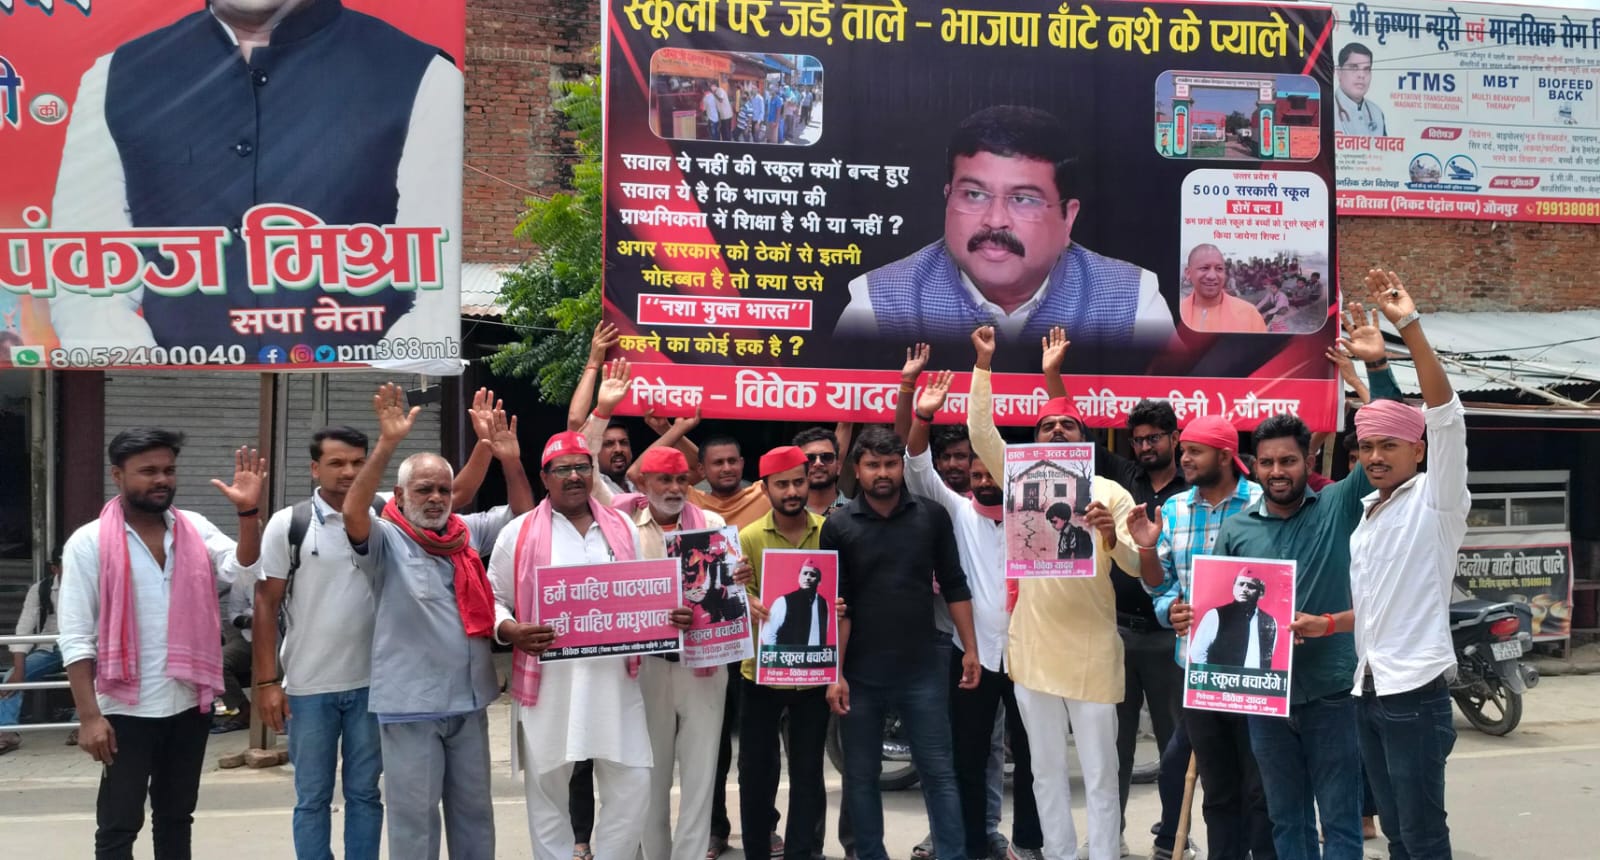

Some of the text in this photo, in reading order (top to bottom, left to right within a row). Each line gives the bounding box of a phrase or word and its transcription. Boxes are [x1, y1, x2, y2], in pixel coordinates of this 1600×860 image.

[727, 0, 772, 37] पर
[842, 0, 907, 43] ताले
[940, 8, 1040, 47] भाजपा
[1048, 2, 1099, 50] बाँटे
[1108, 8, 1161, 55] नशे
[1168, 10, 1201, 53] के
[1210, 12, 1288, 58] प्याले
[1297, 25, 1305, 57] !
[1350, 2, 1369, 37] श्री
[1374, 10, 1420, 45] कृष्णा
[1425, 8, 1461, 50] न्यूरो
[1466, 18, 1485, 43] एवं
[1489, 14, 1556, 47] मानसिक
[1560, 16, 1588, 49] रोग
[1398, 72, 1456, 93] rTMS
[1483, 75, 1519, 89] MBT
[1539, 78, 1593, 90] BIOFEED
[1472, 93, 1491, 101] MULTI
[1548, 90, 1583, 101] BACK
[38, 101, 59, 118] की
[1335, 131, 1405, 152] रिनाथ यादव
[620, 152, 910, 188] सवाल ये नहीं की स्कूल क्यों बन्द हुए
[620, 180, 827, 207] सवाल ये है कि भाजपा की
[1193, 182, 1310, 201] 5000 सरकारी स्कूल
[1253, 205, 1271, 214] बन्द
[1336, 194, 1355, 209] गंज
[1356, 195, 1389, 209] तिराहा
[1391, 195, 1424, 212] (निकट
[1427, 197, 1454, 214] पेट्रोल
[1456, 199, 1481, 216] पम्प)
[1483, 200, 1519, 217] जौनपुर
[620, 207, 903, 235] प्राथमिकता में शिक्षा है भी या नहीं ?
[0, 203, 447, 296] पंकज मिश्रा
[616, 239, 862, 266] अगर सरकार को ठेकों से इतनी
[641, 265, 824, 293] मोहब्बत है तो क्या उसे
[229, 297, 386, 334] सपा नेता
[702, 300, 740, 324] मुक्त
[50, 344, 246, 368] 8052400040
[337, 338, 460, 362] pm368mb
[619, 331, 805, 358] कहने का कोई हक है ?
[631, 376, 704, 406] निवेदक
[735, 370, 819, 409] विवेक
[1457, 552, 1491, 577] दिलीप
[1491, 552, 1514, 576] बाटी
[1543, 551, 1564, 575] वाले
[544, 577, 671, 604] हमें चाहिए पाठशाला
[574, 609, 612, 633] चाहिए
[761, 651, 778, 664] हम
[779, 651, 805, 666] स्कूल
[807, 648, 833, 663] बचायेंगे
[1190, 671, 1208, 685] हम
[1210, 672, 1240, 690] स्कूल
[1242, 673, 1281, 691] बचायेंगे
[1222, 692, 1244, 703] विवेक
[1246, 696, 1268, 705] यादव
